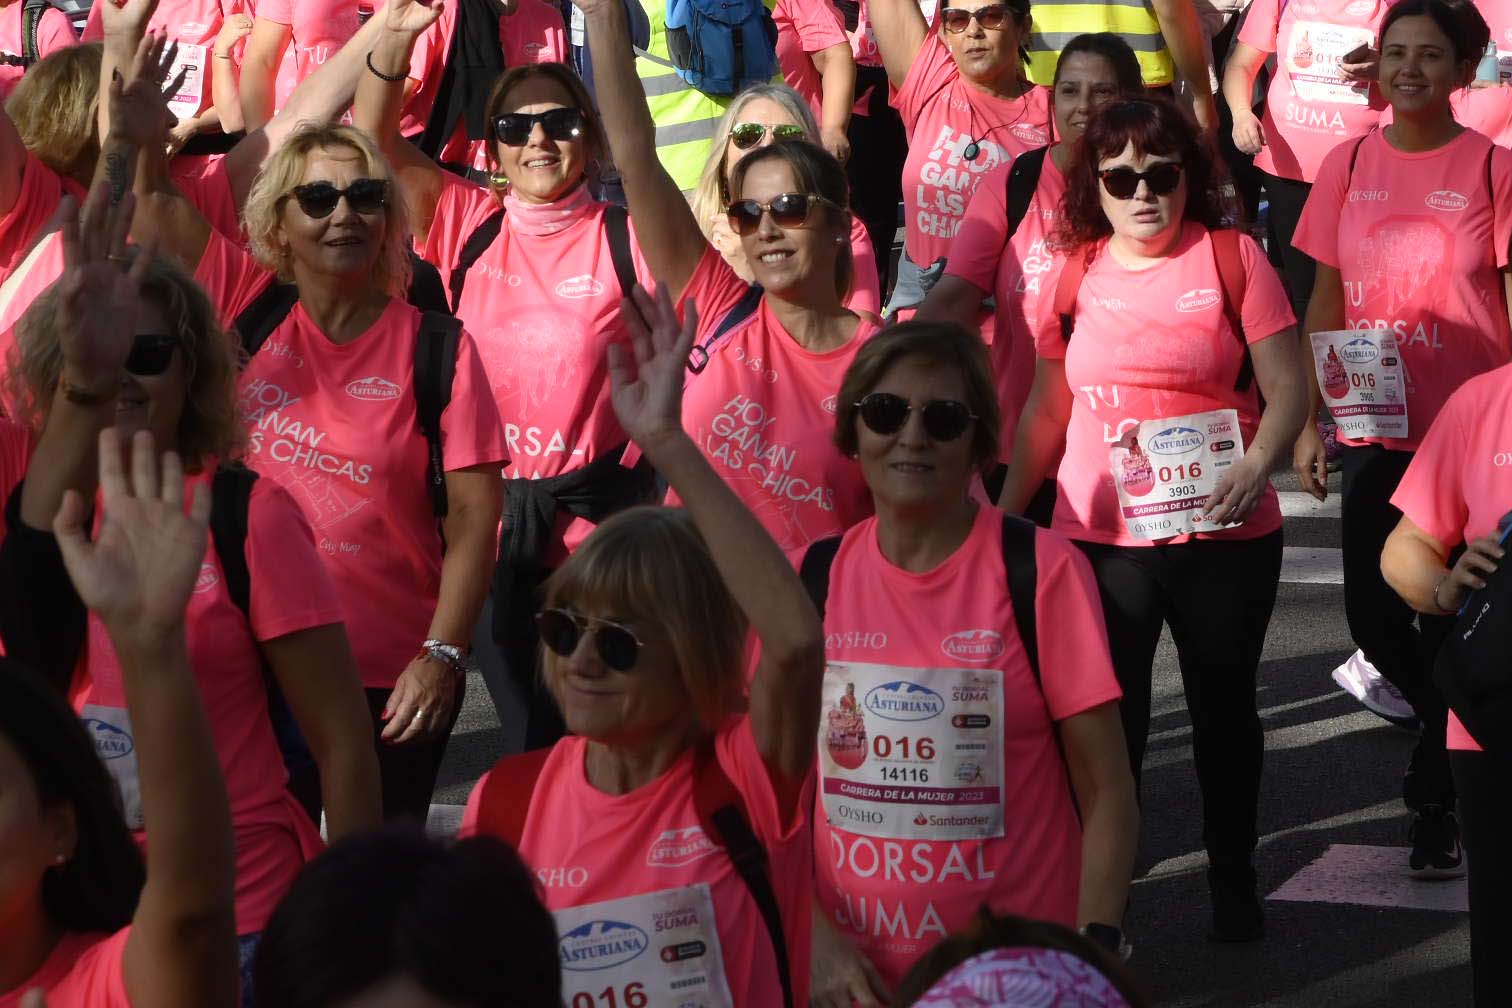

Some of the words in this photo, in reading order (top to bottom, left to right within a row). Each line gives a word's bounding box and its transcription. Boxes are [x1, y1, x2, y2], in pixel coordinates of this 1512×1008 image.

[304, 45, 328, 65] TU
[1286, 103, 1345, 128] SUMA
[917, 185, 964, 214] LAS
[1350, 191, 1388, 202] OYSHO
[1429, 196, 1465, 208] ASTURIANA
[351, 385, 399, 397] ASTURIANA
[1351, 373, 1376, 388] 016
[246, 379, 300, 412] HOY
[1080, 384, 1119, 410] TU
[723, 394, 776, 432] HOY
[247, 406, 326, 448] ANAN
[504, 423, 584, 457] RSA
[712, 414, 796, 470] GANAN
[1151, 434, 1203, 452] ASTURIANA
[271, 439, 372, 484] CHICAS
[1159, 462, 1202, 483] 016
[707, 435, 743, 469] LAS
[748, 463, 833, 511] CHICAS
[1169, 484, 1196, 497] 3903
[1133, 504, 1169, 516] CARRERA
[1171, 503, 1180, 511] DE
[1182, 501, 1192, 509] LA
[1135, 520, 1172, 533] OYSHO
[826, 632, 887, 649] OYSHO
[871, 693, 938, 712] ASTURIANA
[952, 692, 988, 702] SUMA
[873, 735, 935, 760] 016
[880, 767, 929, 783] 14116
[840, 783, 881, 799] CARRERA
[884, 789, 899, 800] DE
[901, 790, 915, 801] LA
[917, 790, 954, 802] MUJER
[838, 804, 883, 824] OYSHO
[929, 815, 990, 827] Santander
[831, 834, 995, 884] DORSAL
[655, 915, 698, 932] SUMA
[835, 888, 949, 939] SUMA
[560, 938, 642, 963] ASTURIANA
[572, 982, 648, 1008] 016
